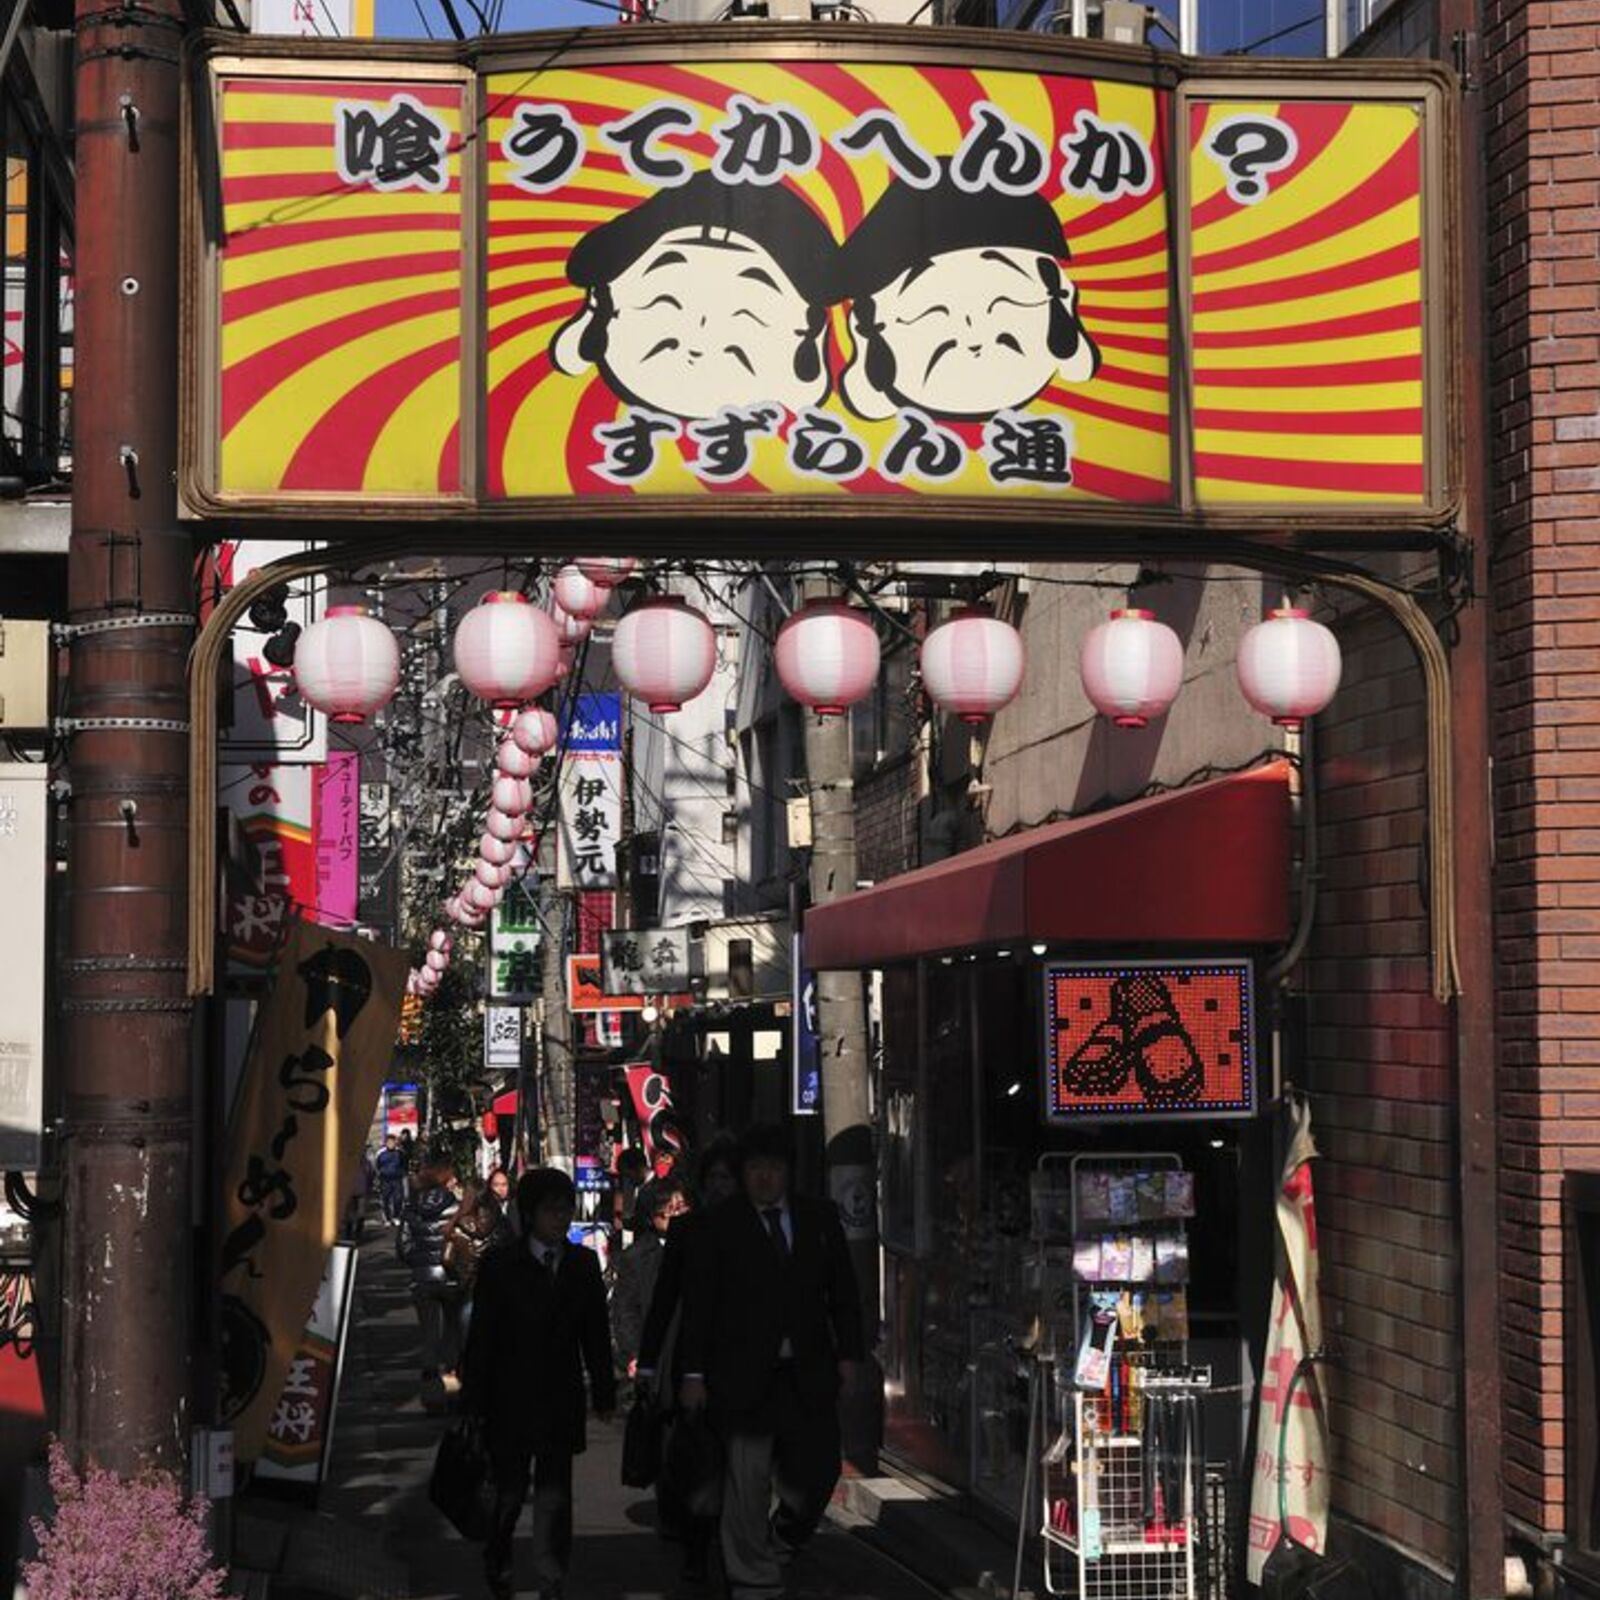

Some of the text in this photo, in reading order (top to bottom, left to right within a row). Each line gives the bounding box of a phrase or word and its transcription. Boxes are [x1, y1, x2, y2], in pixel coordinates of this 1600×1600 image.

[598, 407, 1073, 485] すずらん通
[572, 774, 610, 875] 伊勢元
